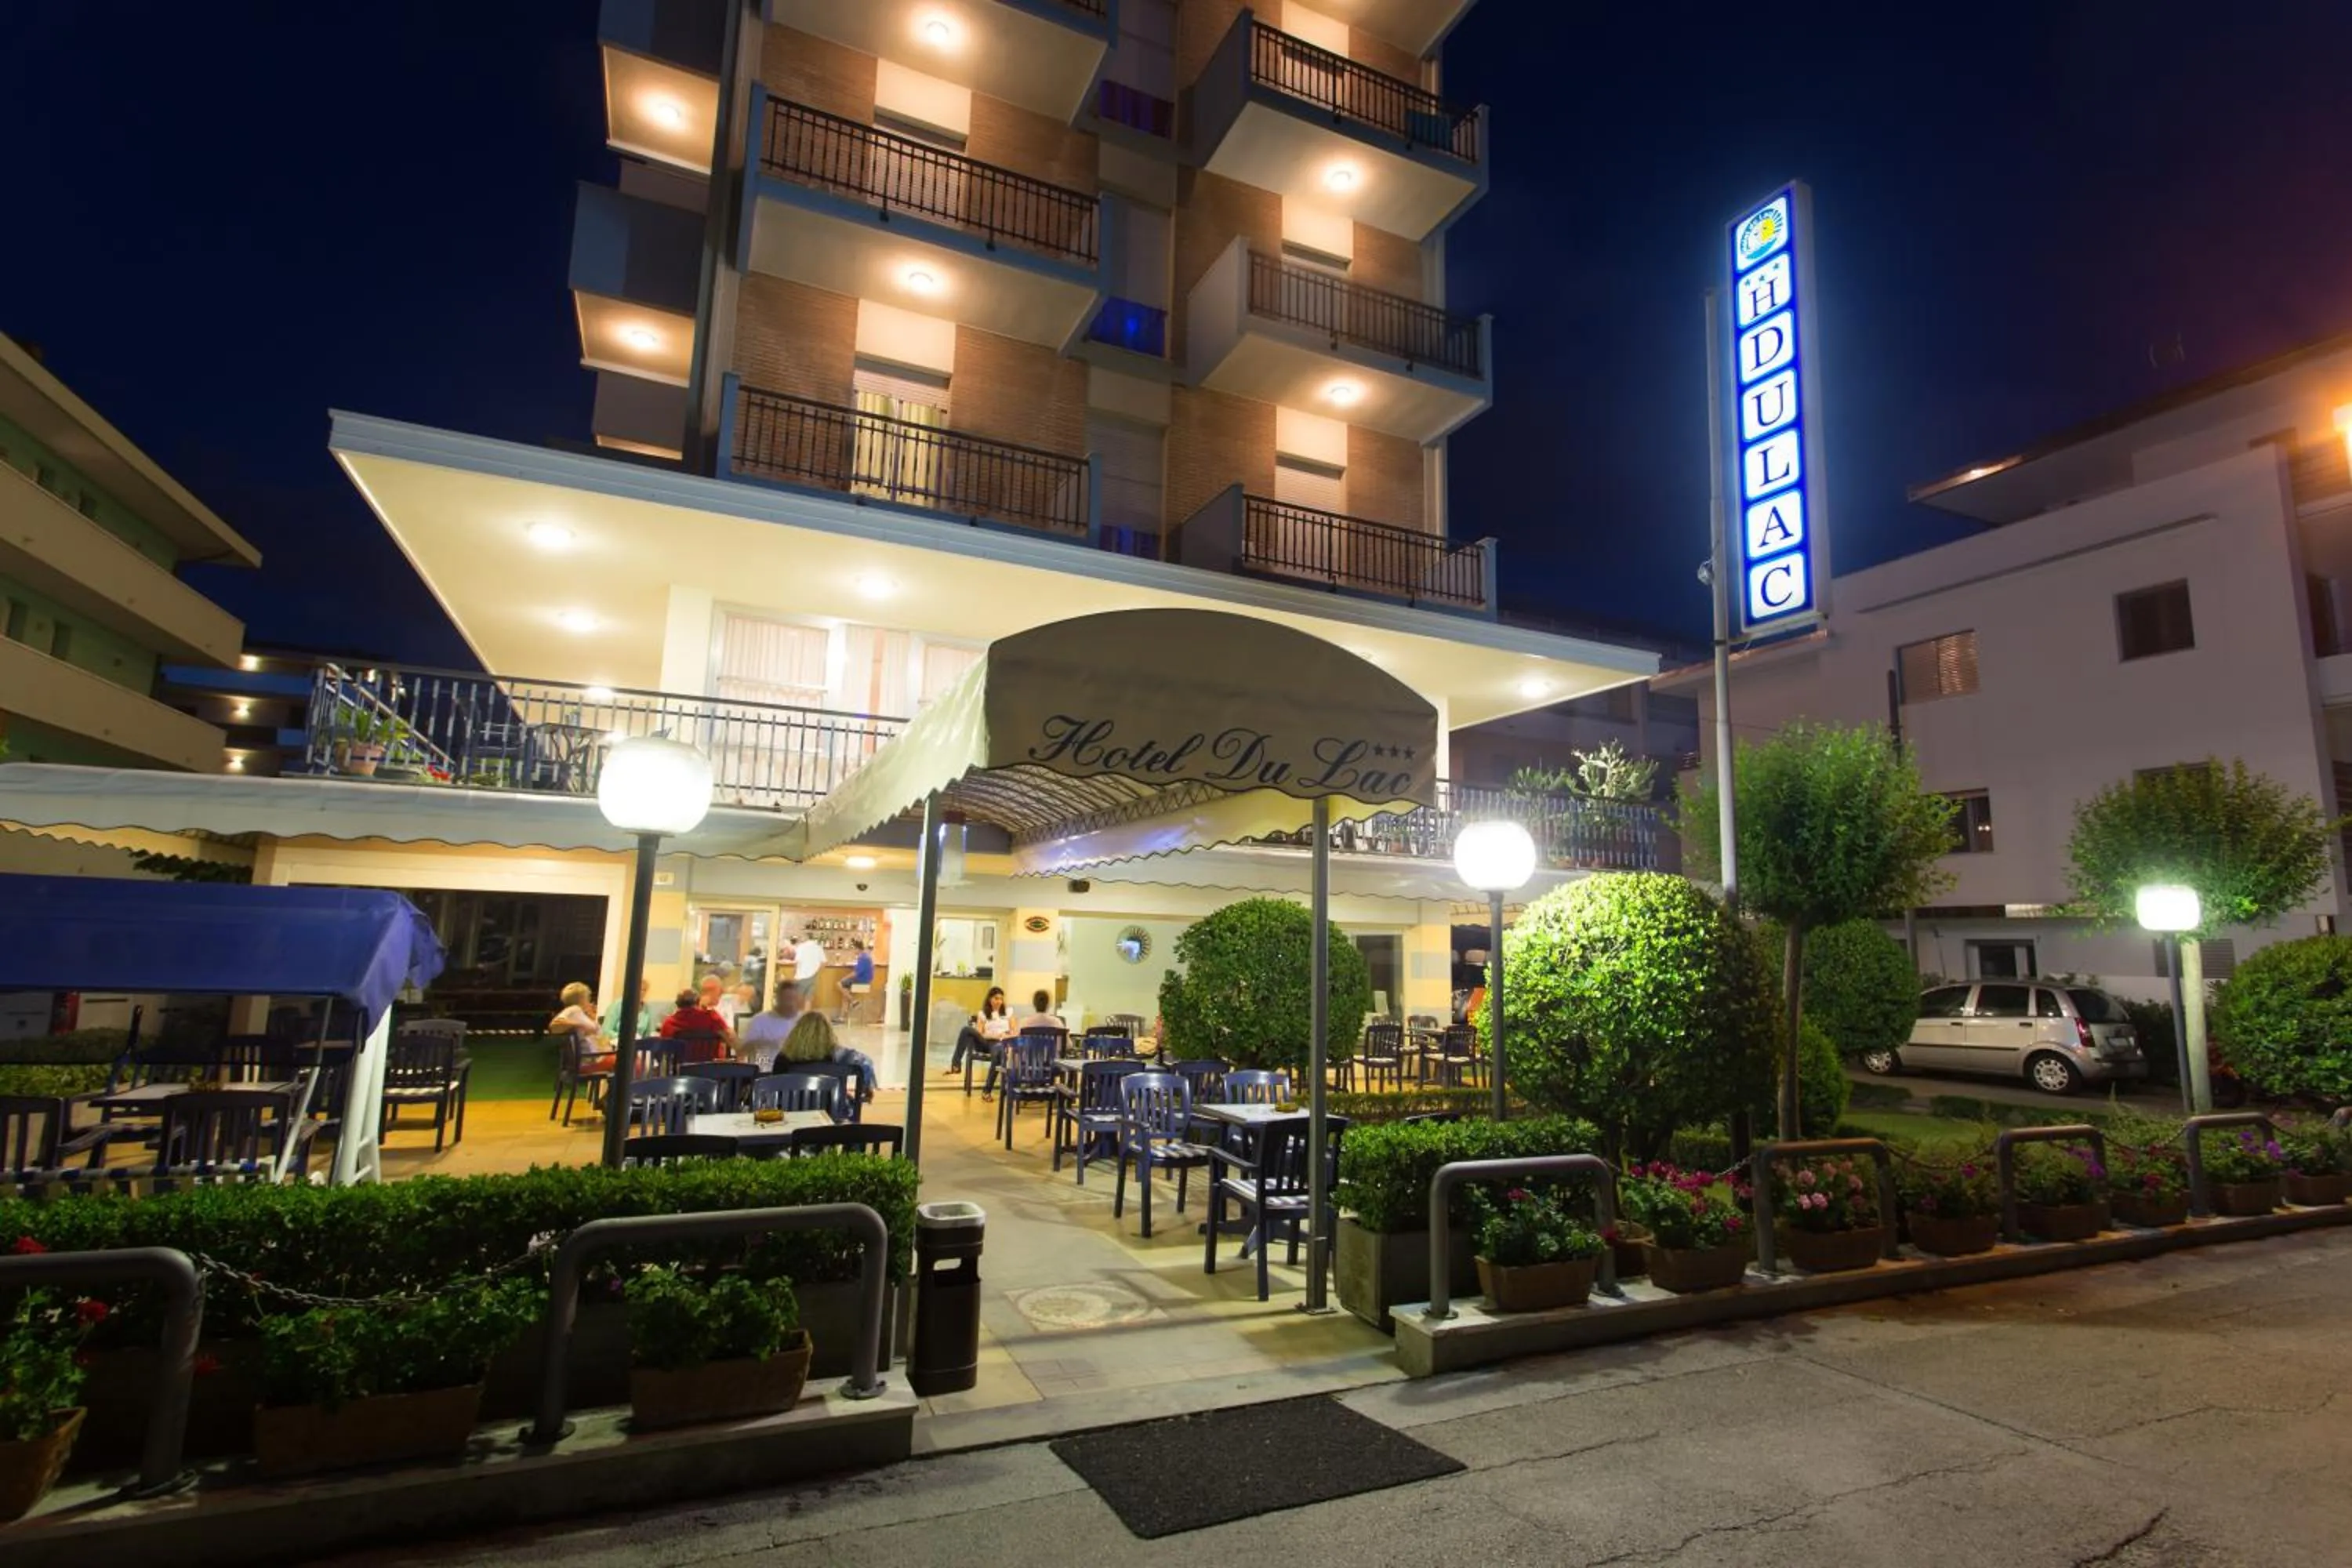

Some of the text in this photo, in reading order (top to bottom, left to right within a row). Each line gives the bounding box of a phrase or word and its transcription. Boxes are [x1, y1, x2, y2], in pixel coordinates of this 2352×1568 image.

[1028, 714, 1410, 796] Hotel Du Lac
